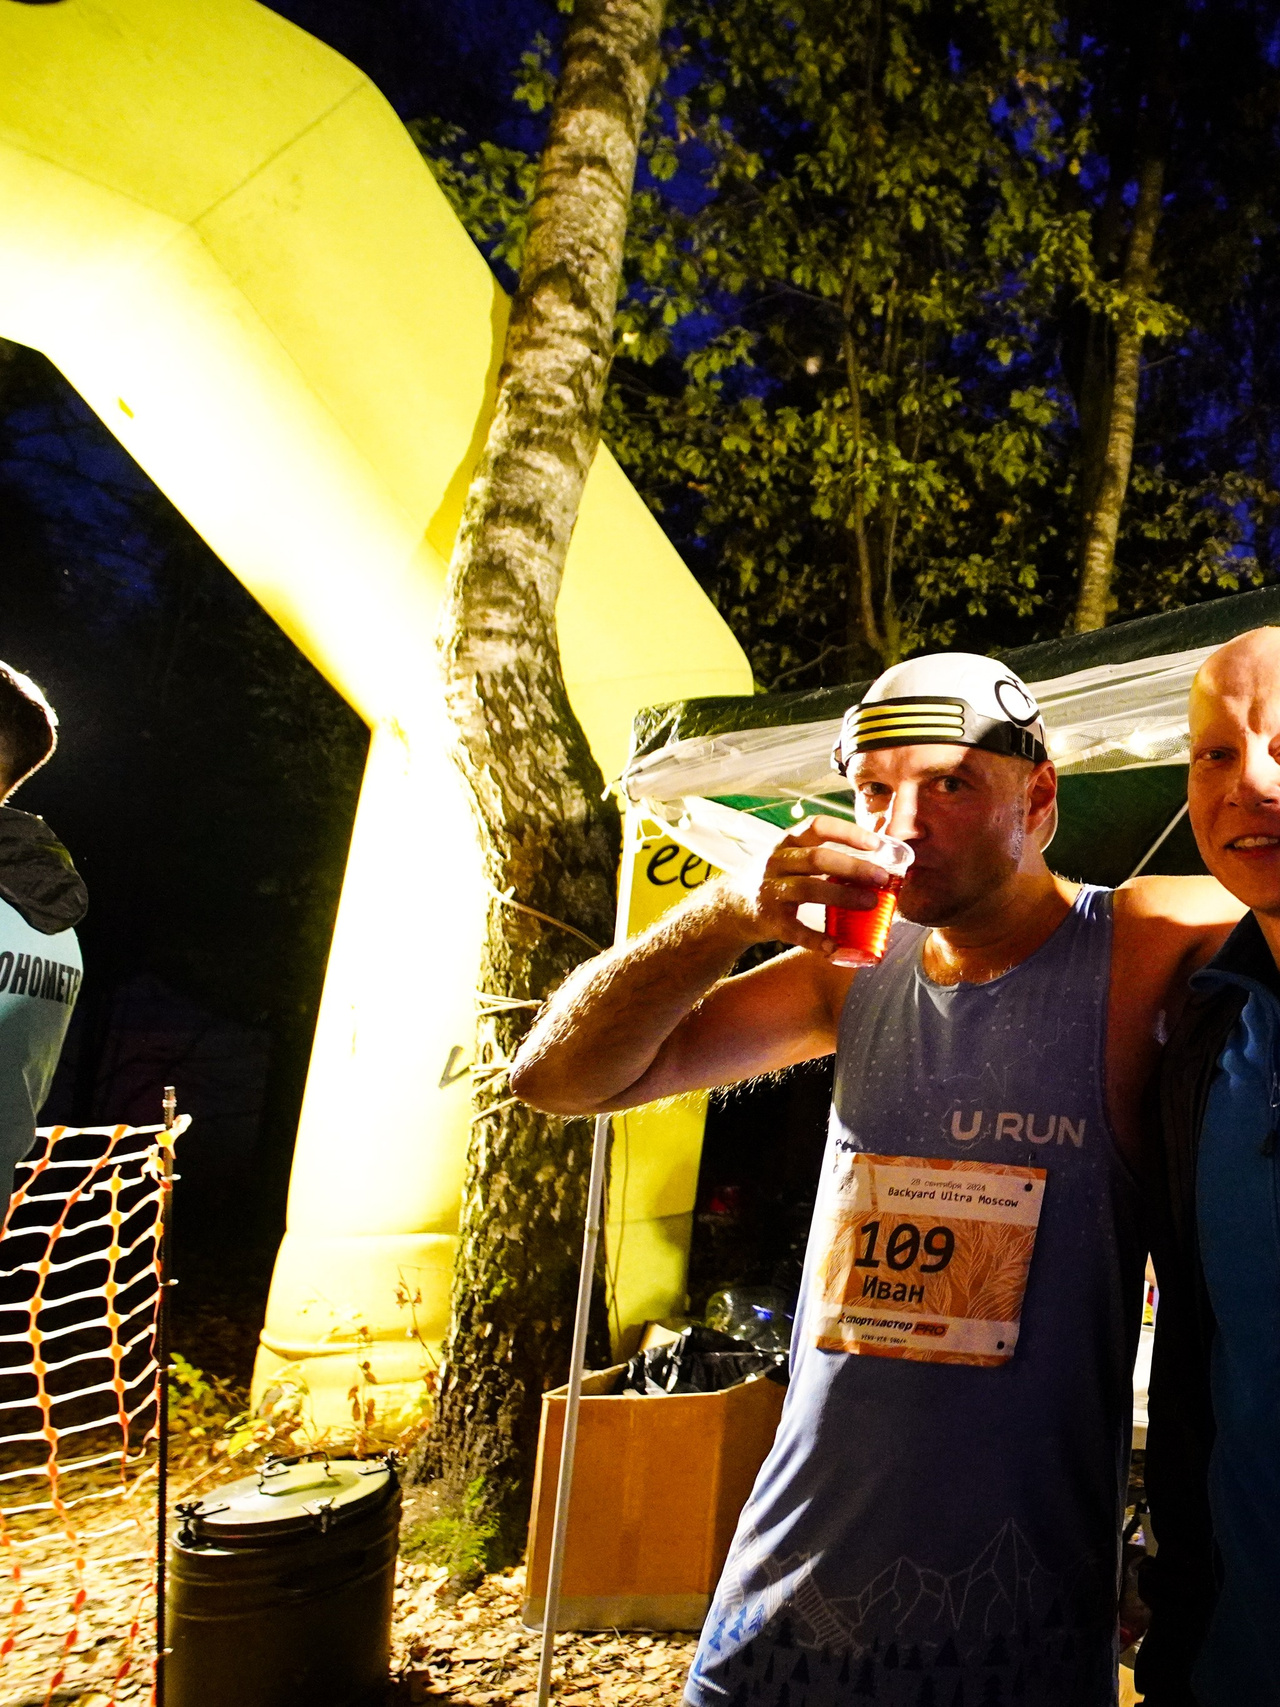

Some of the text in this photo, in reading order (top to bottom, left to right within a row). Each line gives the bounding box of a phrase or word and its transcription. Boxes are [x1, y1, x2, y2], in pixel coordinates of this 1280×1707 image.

[951, 1110, 1087, 1147] U RUN
[887, 1186, 1019, 1208] Backyard Ultra Moscow
[924, 1180, 962, 1190] сентября
[966, 1182, 986, 1192] 2024
[855, 1220, 955, 1273] 109
[861, 1275, 925, 1303] Иван
[914, 1323, 947, 1336] PRO
